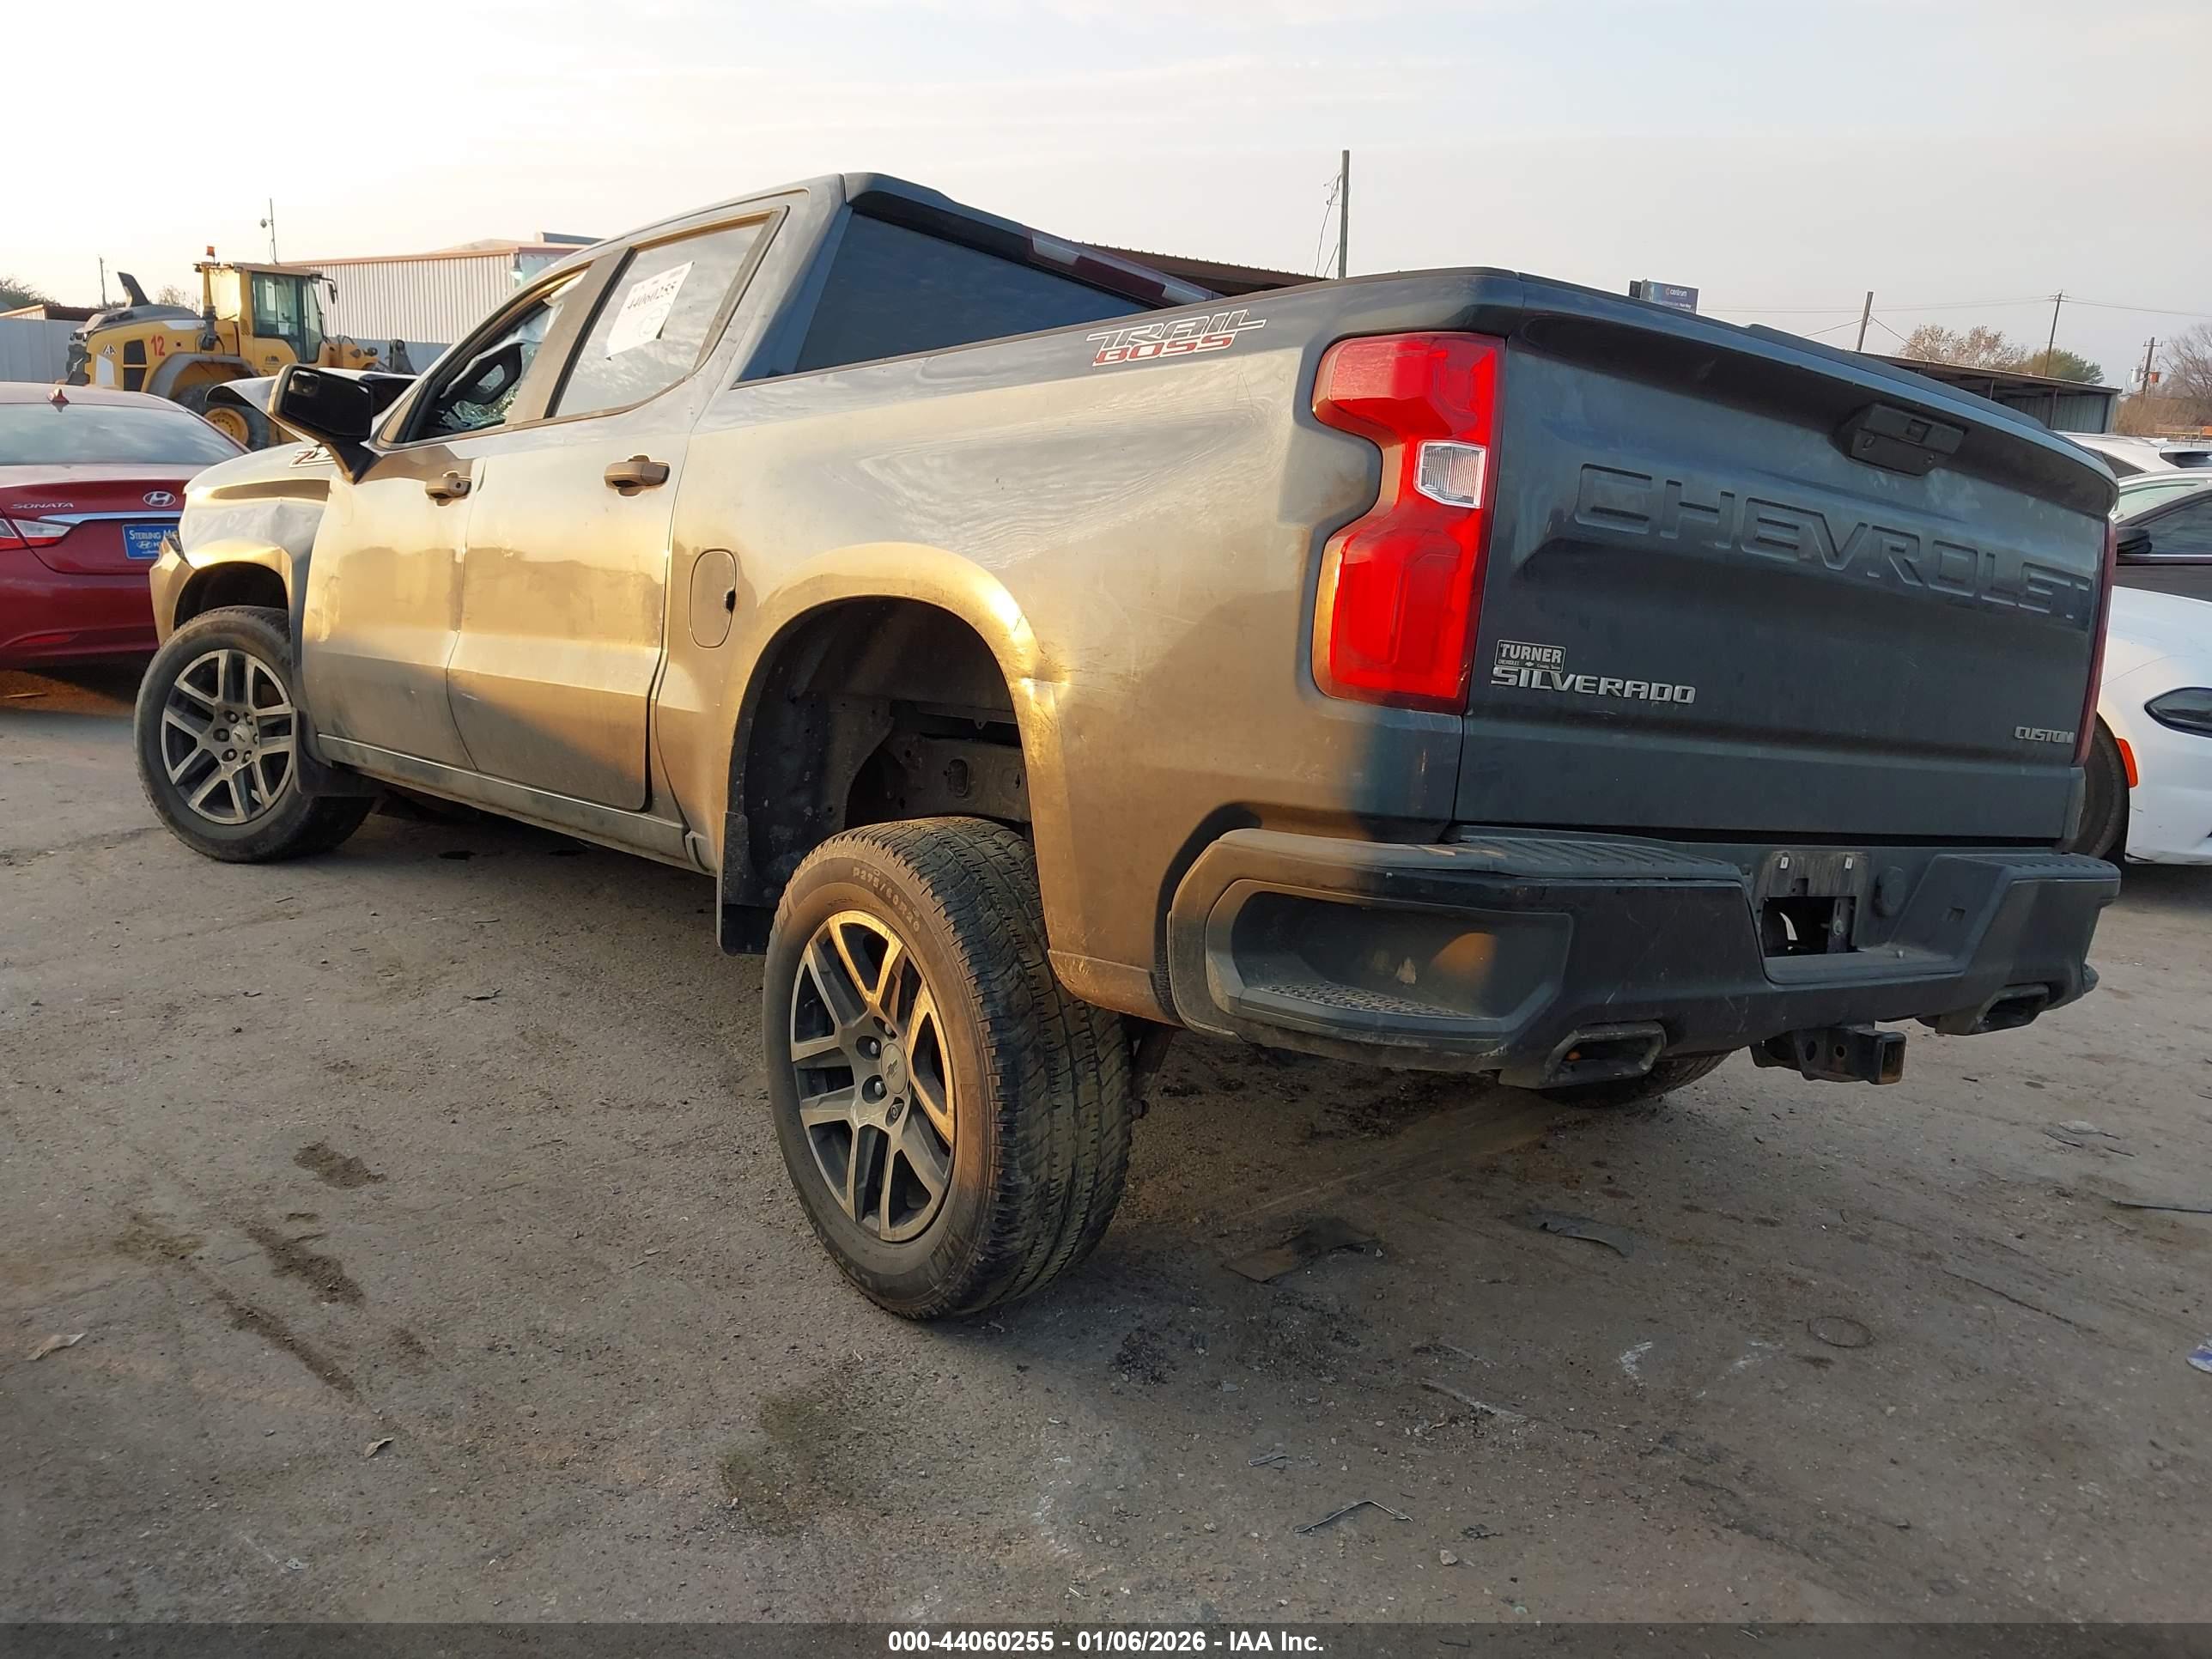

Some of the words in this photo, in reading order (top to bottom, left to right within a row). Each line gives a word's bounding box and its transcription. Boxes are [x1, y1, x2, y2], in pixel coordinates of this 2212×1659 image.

[150, 335, 165, 356] 12
[1086, 309, 1267, 349] TRAIL
[1092, 331, 1237, 366] BOSS
[1574, 463, 2092, 620] CHEVROLET
[1500, 643, 1562, 664] TURNER
[1491, 666, 1696, 704] SILVERADO
[2014, 726, 2075, 744] CUSTOM
